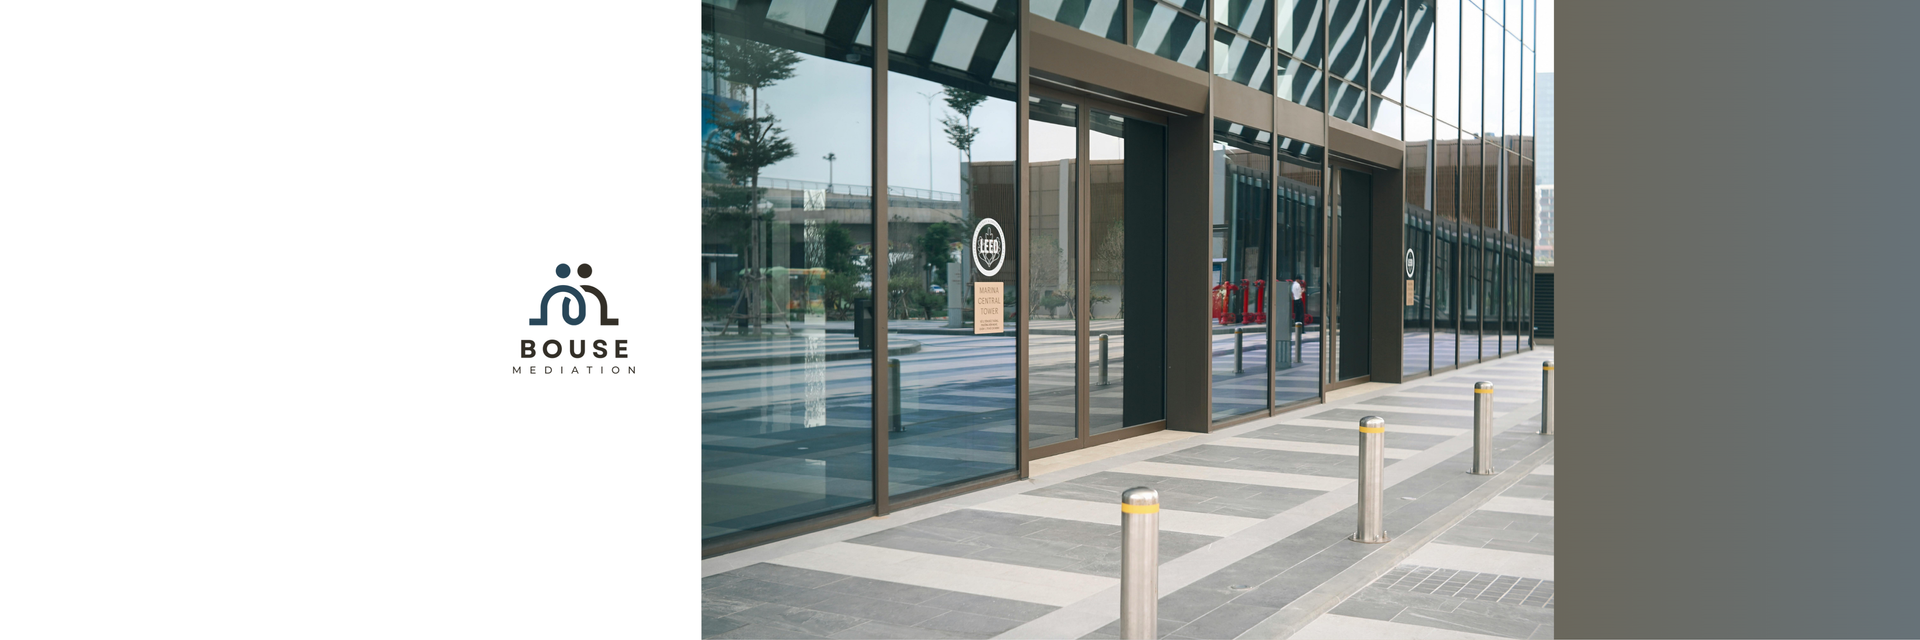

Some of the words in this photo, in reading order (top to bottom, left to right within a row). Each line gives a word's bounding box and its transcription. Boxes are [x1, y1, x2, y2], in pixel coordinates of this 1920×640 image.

[980, 238, 999, 254] LEED
[979, 286, 999, 294] MARINA
[978, 297, 1001, 305] CENTRAL
[980, 307, 999, 315] TOWER
